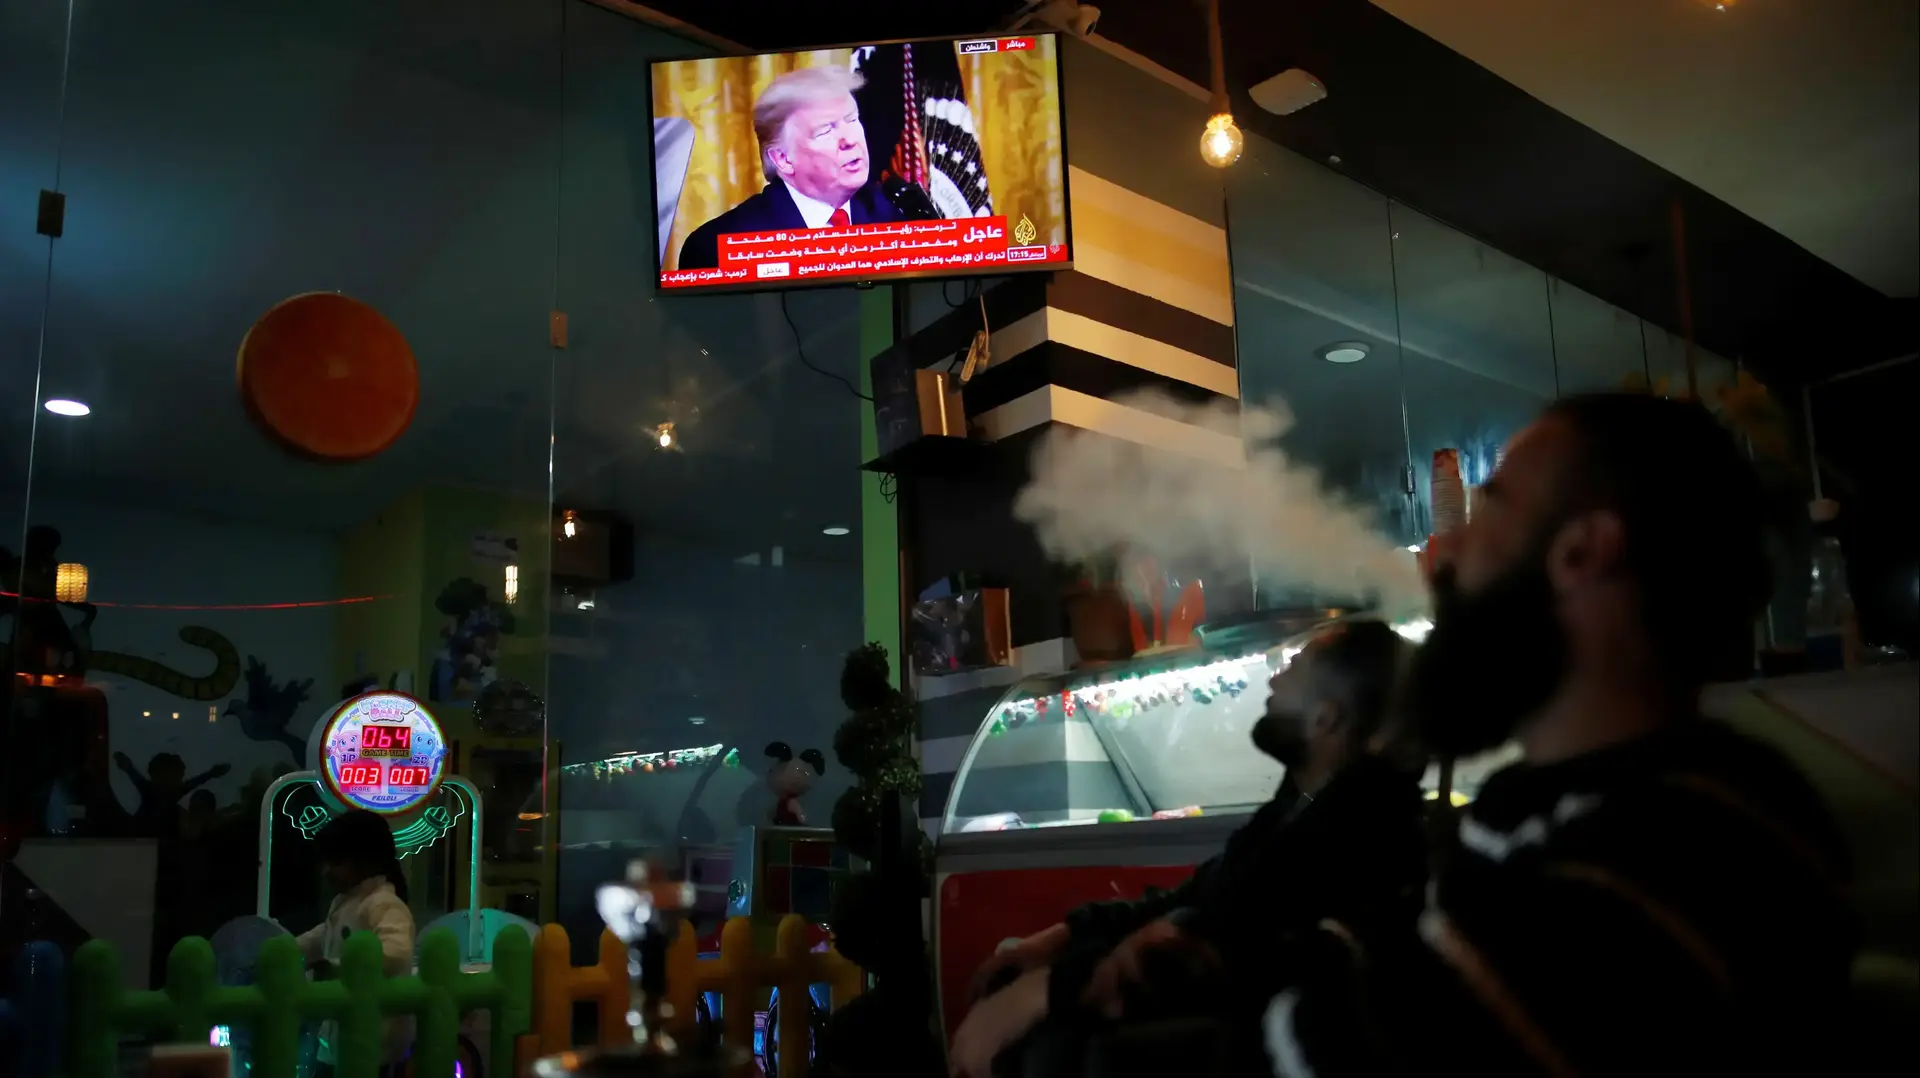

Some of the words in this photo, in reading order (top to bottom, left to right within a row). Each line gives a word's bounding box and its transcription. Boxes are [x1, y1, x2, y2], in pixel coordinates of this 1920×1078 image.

[965, 42, 991, 51] واشنطن
[1006, 40, 1026, 49] مباشر
[813, 228, 859, 240] للسلام
[861, 224, 912, 235] رؤيتنا
[963, 225, 1003, 243] عاجل
[727, 235, 774, 245] صفحة
[776, 233, 786, 241] 80
[789, 233, 811, 242] من
[838, 243, 848, 255] أي
[849, 244, 868, 253] من
[870, 240, 898, 252] أكثر
[900, 239, 958, 249] ومفصلة
[765, 248, 803, 257] وضعت
[804, 245, 836, 255] خطة
[1010, 250, 1029, 259] 17:15
[727, 251, 764, 260] سابقا
[945, 253, 972, 264] الإرهاب
[974, 251, 983, 261] أن
[985, 251, 1005, 260] تدرك
[874, 258, 908, 270] الإسلامي
[910, 256, 944, 266] والتطرف
[699, 269, 723, 280] شعرت
[763, 268, 783, 276] عاجل
[798, 264, 825, 275] للجميع
[669, 271, 697, 282] بإعجاب
[342, 754, 356, 763] 1P
[341, 767, 379, 784] 003
[389, 768, 426, 784] 007
